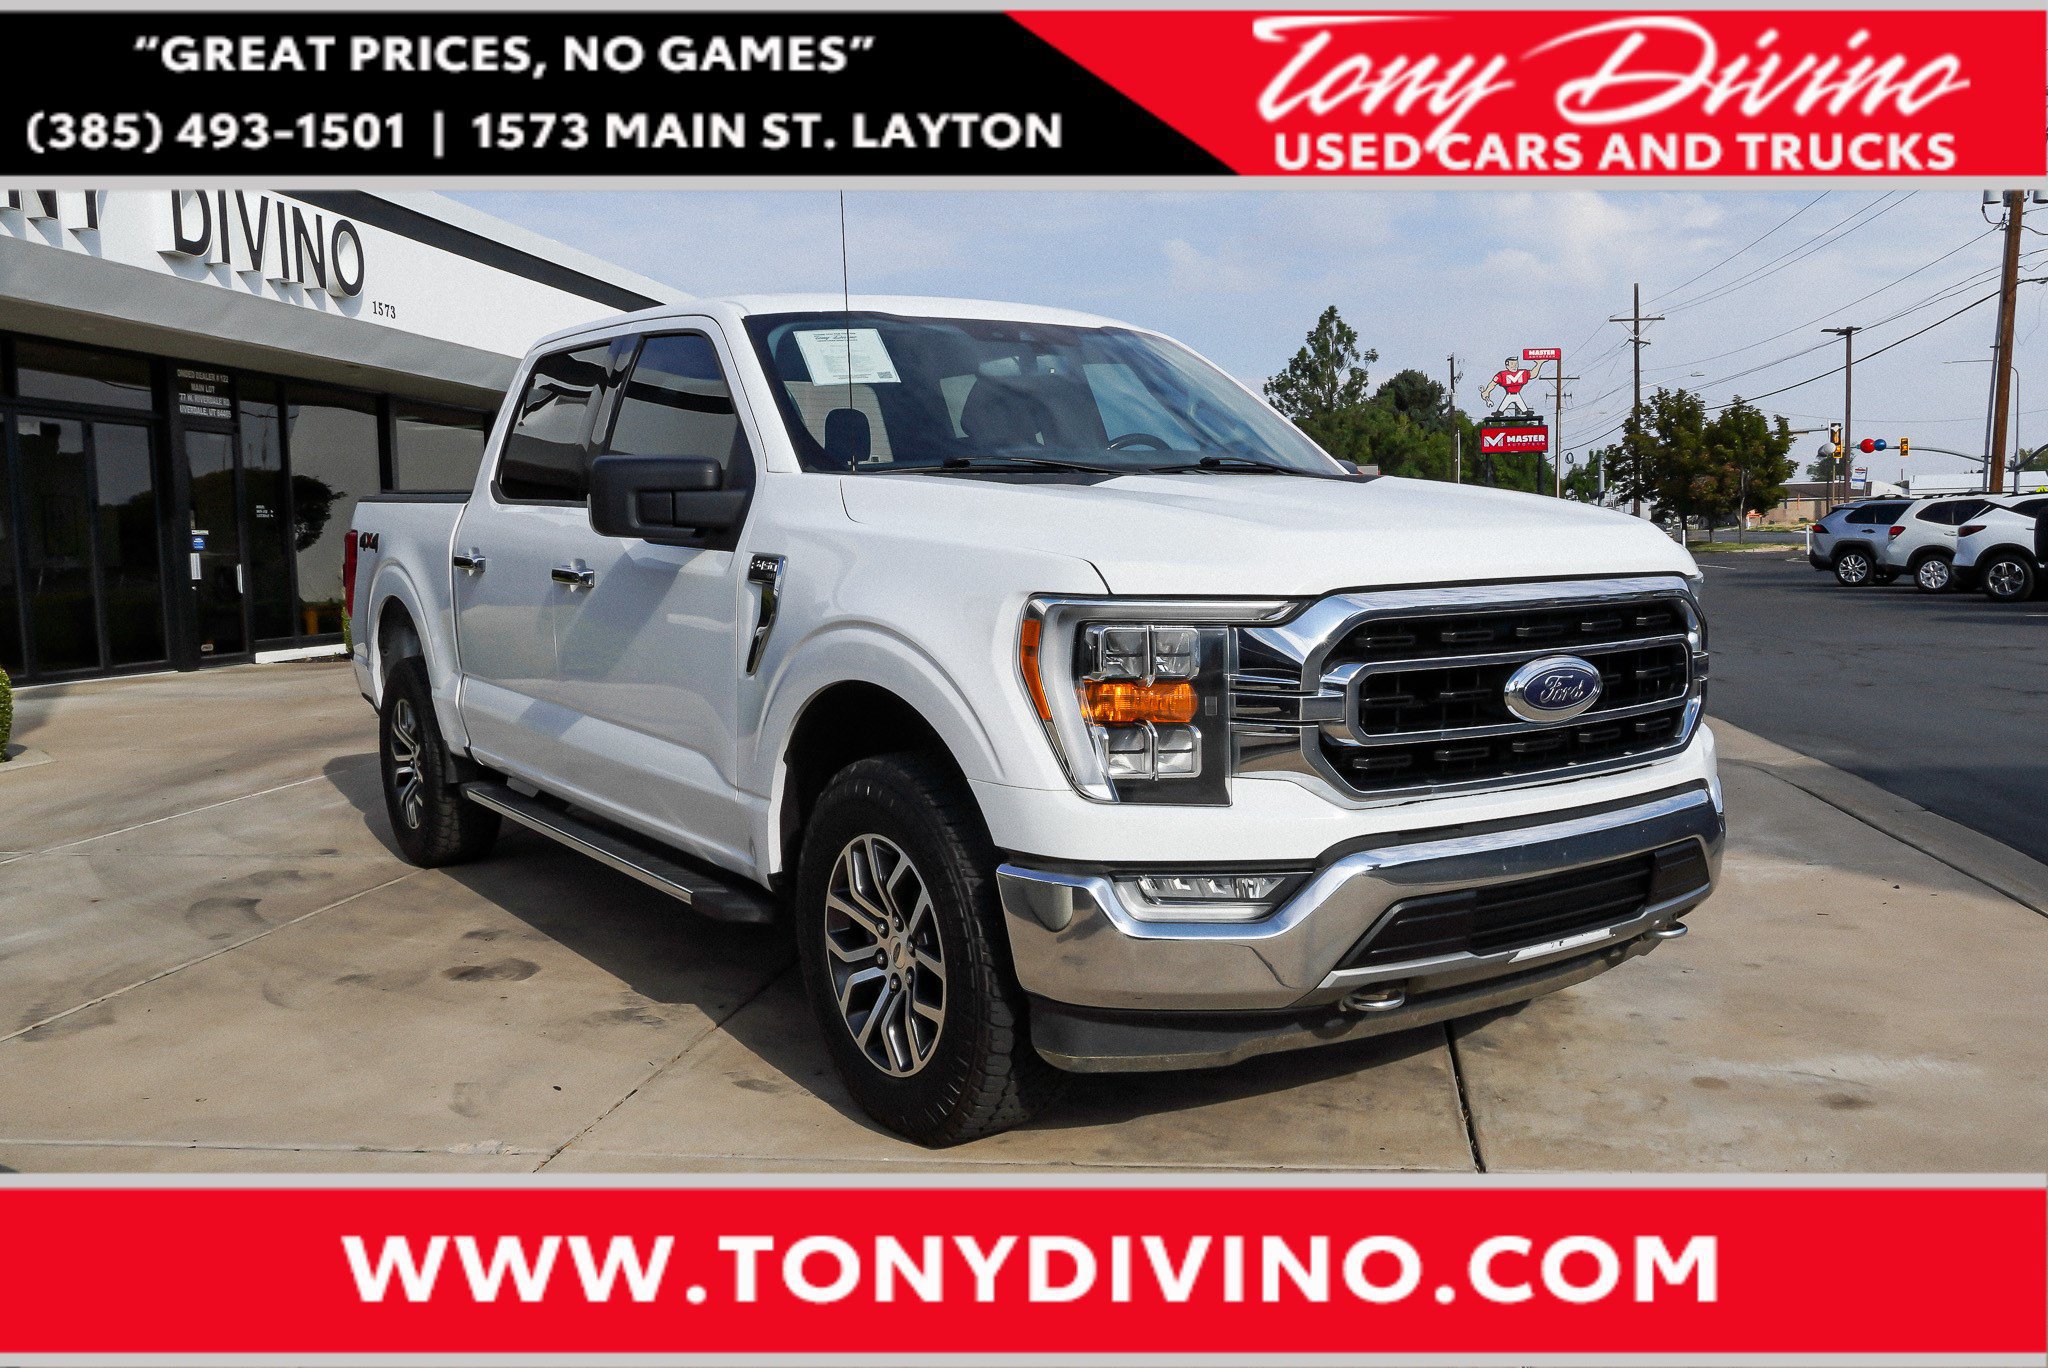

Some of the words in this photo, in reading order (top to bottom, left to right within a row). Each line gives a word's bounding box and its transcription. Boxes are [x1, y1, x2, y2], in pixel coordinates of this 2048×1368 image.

[171, 188, 365, 297] DIVINO
[372, 300, 397, 320] 1573
[1506, 434, 1546, 443] MASTER
[1540, 674, 1584, 704] Ford
